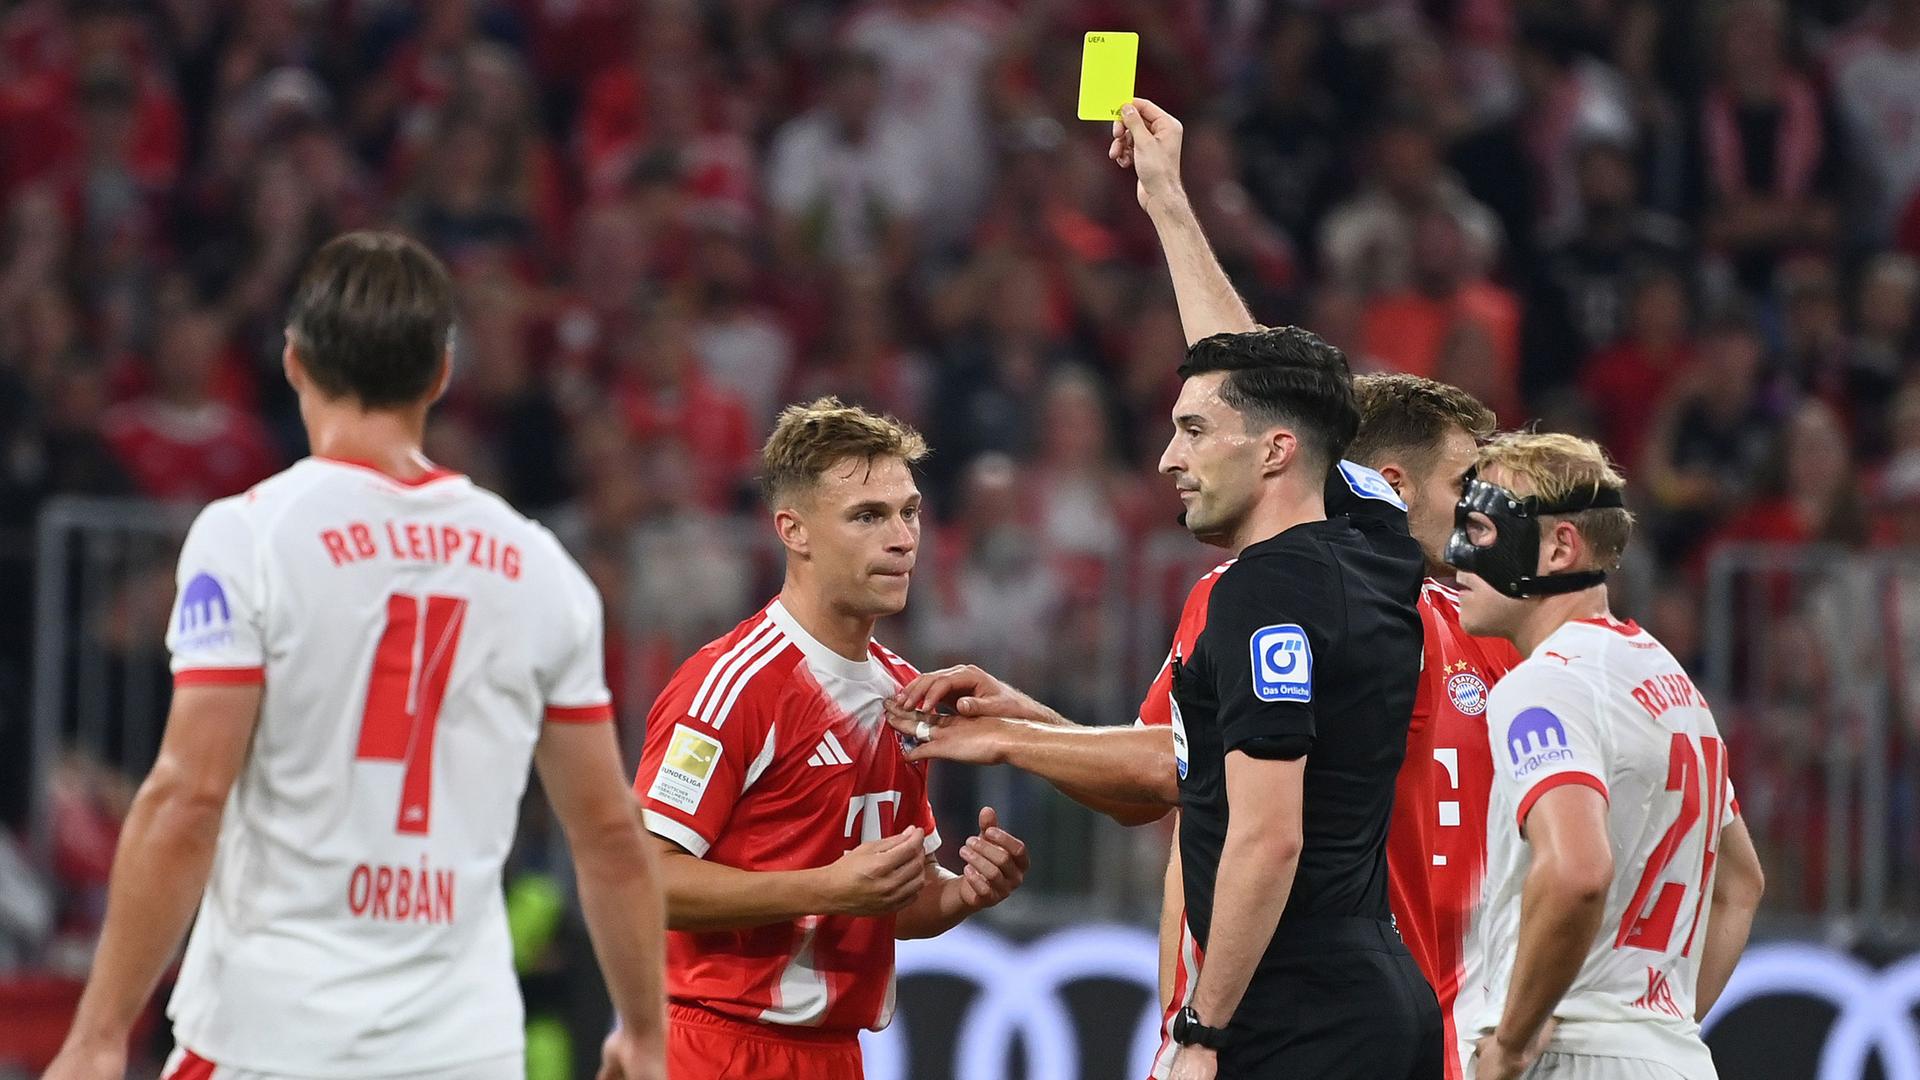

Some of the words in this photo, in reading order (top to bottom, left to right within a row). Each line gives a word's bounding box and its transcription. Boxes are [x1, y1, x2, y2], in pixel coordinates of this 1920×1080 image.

[320, 521, 377, 567] RB
[385, 520, 523, 581] LEIPZIG
[1263, 687, 1279, 696] Das
[1455, 676, 1485, 692] BAYERN
[1631, 679, 1669, 721] RB
[355, 591, 470, 835] 4
[1514, 747, 1574, 778] kraken
